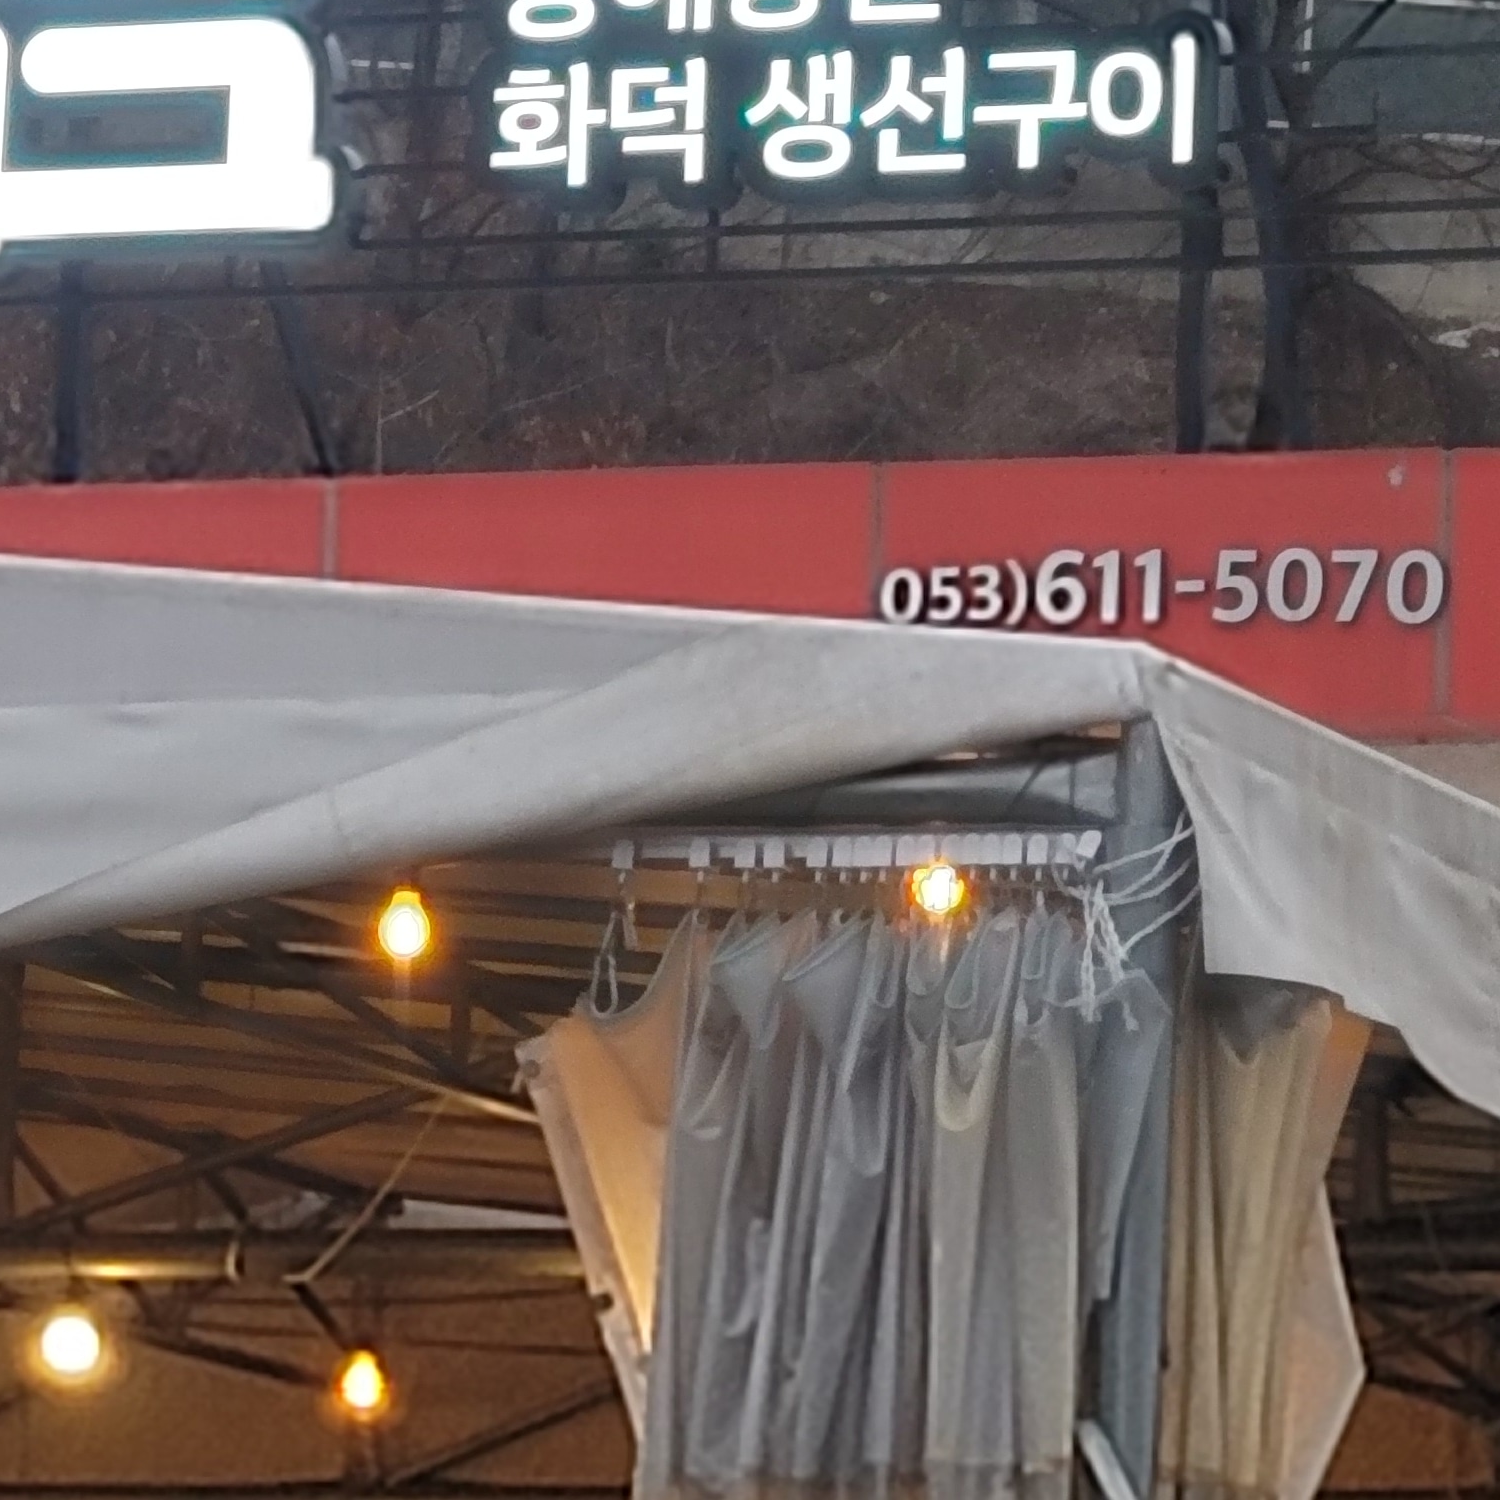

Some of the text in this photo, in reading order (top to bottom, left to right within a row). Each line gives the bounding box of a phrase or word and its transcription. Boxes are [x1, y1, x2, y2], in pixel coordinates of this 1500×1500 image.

[490, 32, 1195, 187] 화덕 생선구이
[880, 548, 1445, 626] 053)611-5070
